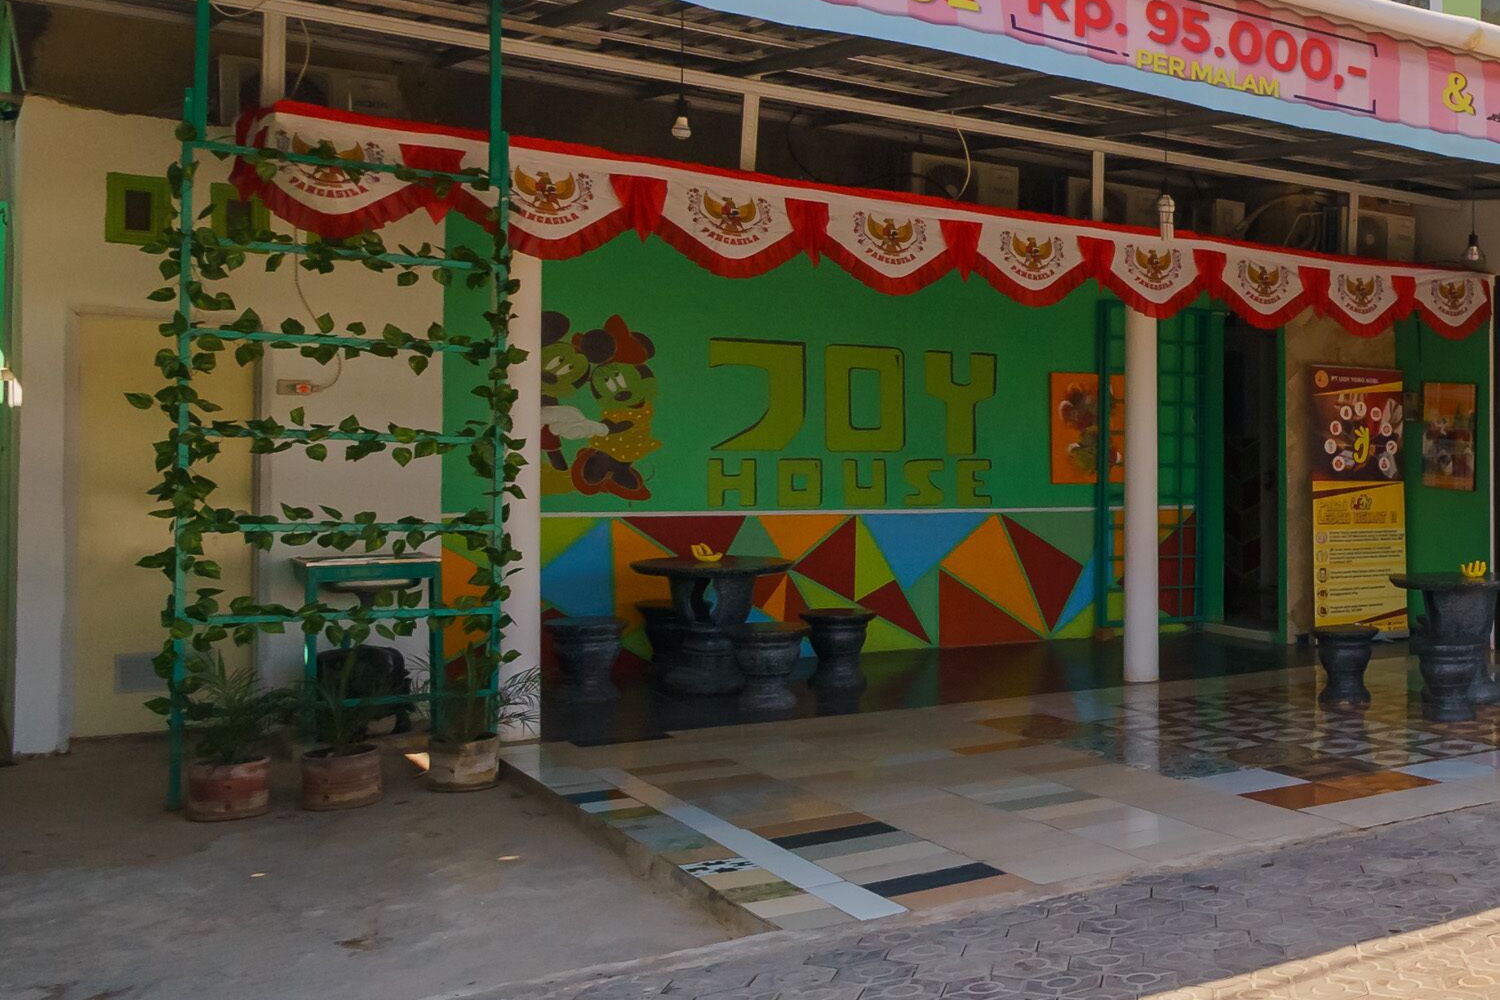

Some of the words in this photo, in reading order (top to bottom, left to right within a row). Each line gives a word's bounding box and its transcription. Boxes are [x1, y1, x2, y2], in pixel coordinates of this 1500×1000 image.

[1146, 0, 1366, 90] 95.000,-
[1136, 48, 1186, 77] PER
[1190, 61, 1280, 97] MALAM
[1442, 71, 1476, 115] &
[519, 208, 579, 225] ANCASILA
[701, 226, 760, 245] PANCASILA
[865, 247, 916, 265] PANCASILA
[708, 338, 998, 454] JOY
[707, 457, 993, 507] HOUSE
